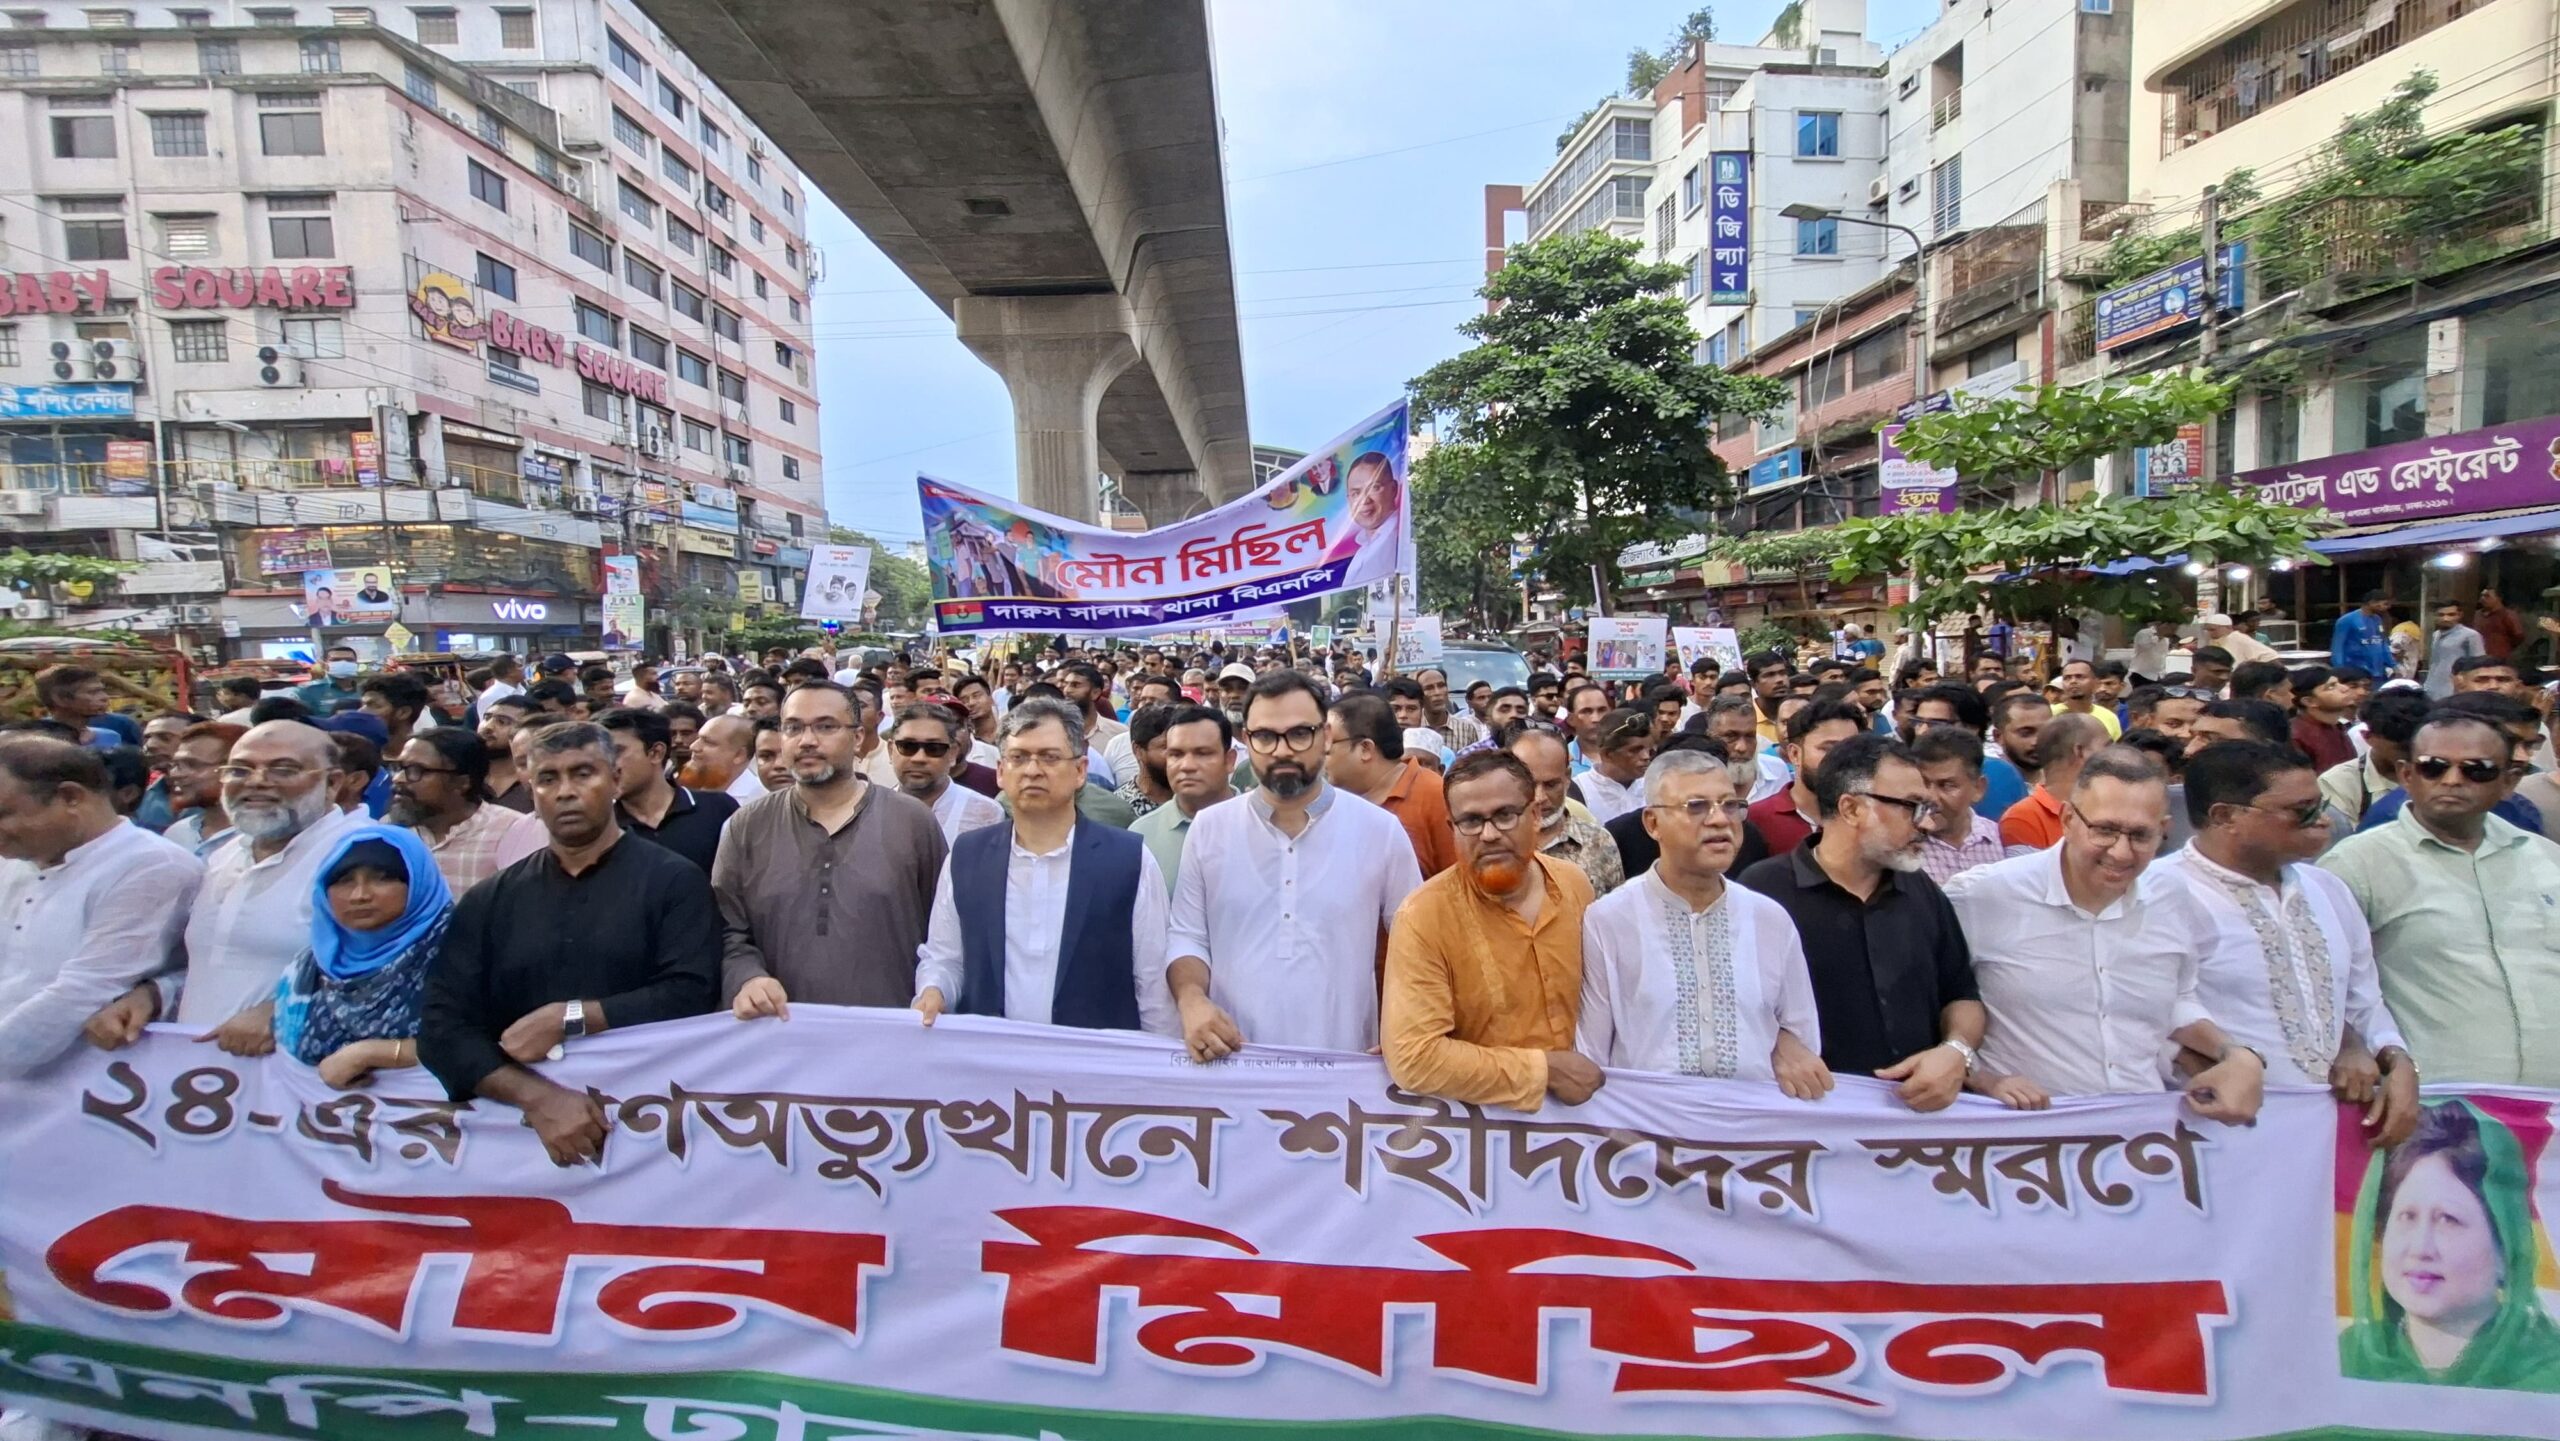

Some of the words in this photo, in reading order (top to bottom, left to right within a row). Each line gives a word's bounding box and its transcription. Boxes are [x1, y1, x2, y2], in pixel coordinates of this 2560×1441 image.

[153, 265, 354, 309] SQUARE
[491, 309, 565, 368] BABY
[576, 342, 667, 405] SQUARE
[2336, 467, 2382, 498] এন্ড
[2390, 436, 2523, 493] রেস্টুরেন্ট
[1056, 552, 1165, 590] মৌন
[1177, 518, 1327, 582] মিছিল
[492, 598, 547, 620] vivo
[989, 603, 1062, 620] দারুস
[1066, 603, 1152, 622] সালাম
[1162, 595, 1221, 616] থানা
[1229, 568, 1336, 606] বিএনপি
[83, 1062, 476, 1165] ২৪-এর
[1261, 1084, 1828, 1216] শহীদদের
[1857, 1119, 2210, 1214] স্মরণে
[46, 1179, 887, 1336] মৌন
[982, 1205, 2229, 1407] মিছিল
